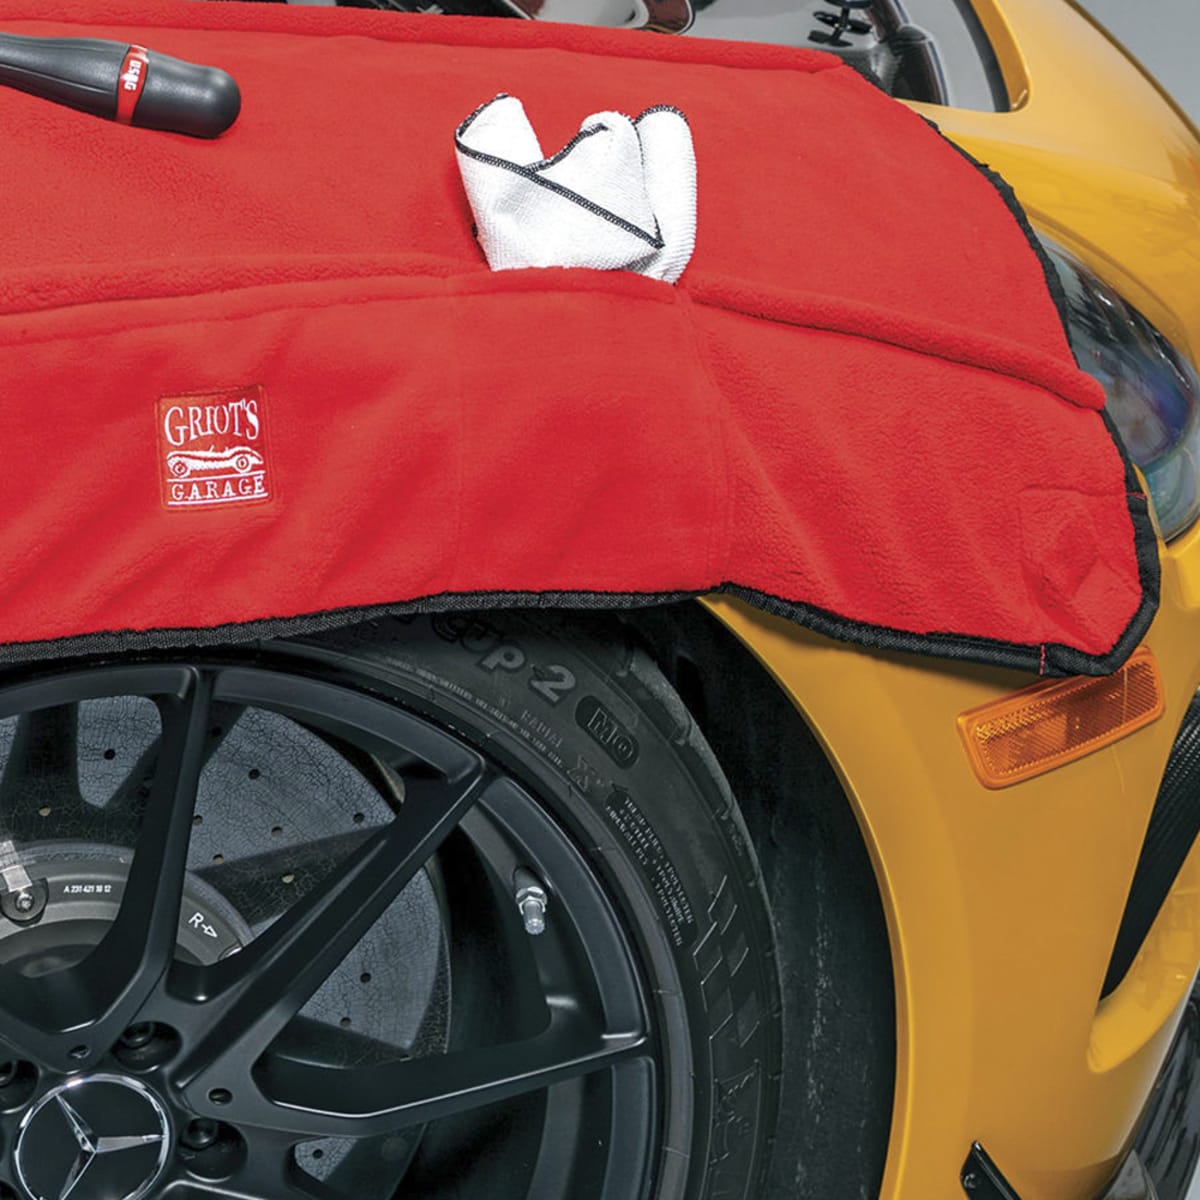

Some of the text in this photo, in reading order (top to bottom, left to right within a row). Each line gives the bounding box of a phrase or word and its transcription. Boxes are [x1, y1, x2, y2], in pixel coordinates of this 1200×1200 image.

[164, 399, 260, 446] GRIOT'S
[171, 475, 266, 501] GARAGE
[530, 664, 577, 703] 2
[188, 911, 205, 929] R
